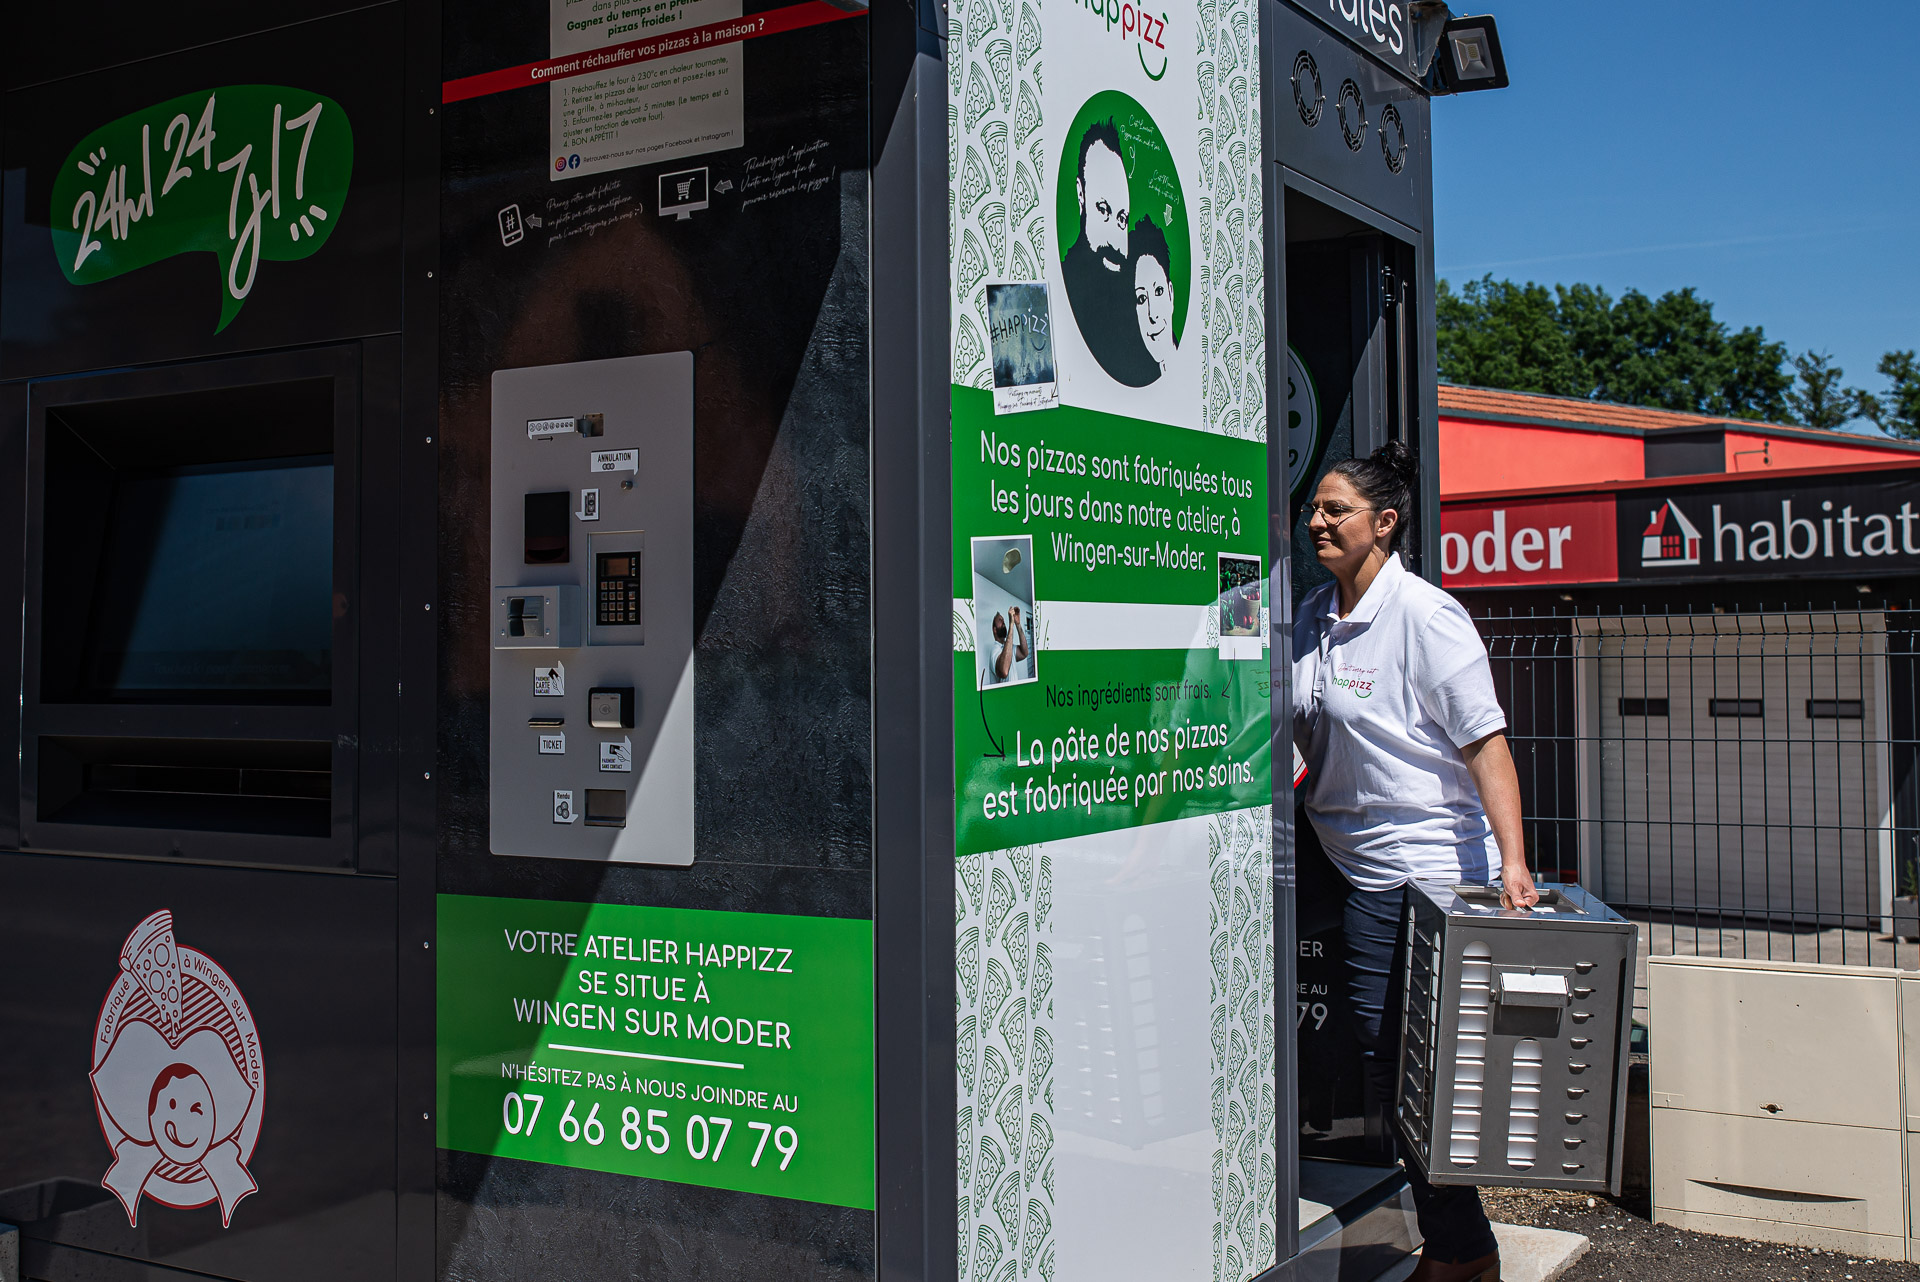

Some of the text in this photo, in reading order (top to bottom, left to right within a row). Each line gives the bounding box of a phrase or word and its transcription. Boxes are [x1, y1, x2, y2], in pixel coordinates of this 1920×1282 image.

[566, 1, 667, 31] Gagnez du temps en
[592, 2, 612, 12] dans
[608, 12, 676, 38] pizzas froides
[531, 18, 765, 79] Comment réchauffer vos pizzas à la maison ?
[594, 92, 603, 100] les
[604, 88, 625, 100] pizzas
[627, 85, 636, 93] de
[637, 82, 649, 91] leur
[651, 79, 671, 89] carton
[718, 67, 729, 75] sur
[616, 76, 629, 85] four
[670, 63, 693, 75] chaleur
[643, 103, 649, 111] 5
[651, 99, 675, 110] minutes
[690, 92, 709, 103] temps
[712, 90, 722, 98] est
[563, 127, 583, 139] ajuster
[584, 126, 592, 134] en
[594, 121, 619, 133] fonction
[620, 118, 629, 127] de
[631, 116, 647, 125] votre
[571, 136, 588, 147] BON
[647, 144, 664, 153] pages
[665, 137, 692, 149] Facebook
[598, 452, 632, 463] ANNULATION
[980, 430, 1253, 499] Nos pizzas sont fabriquées tous
[991, 479, 1241, 540] les jours dans notre atelier, à
[1713, 499, 1920, 562] habitat
[1051, 532, 1207, 572] Wingen-sur-Moder.
[536, 681, 550, 689] CARTE
[1046, 679, 1212, 712] Nos ingrédients sont frais.
[543, 740, 563, 750] TICKET
[1016, 718, 1228, 773] La pâte de nos pizzas
[557, 792, 570, 800] Rendu
[983, 755, 1254, 821] est fabriquée par nos soins.
[504, 928, 794, 974] VOTRE ATELIER HAPPIZZ
[578, 969, 711, 1005] SE SITUE À
[1311, 984, 1328, 995] AU
[100, 954, 261, 1089] Fabriqué à Wingen sur Moder
[513, 997, 792, 1050] WINGEN SUR MODER
[1297, 1002, 1328, 1031] 79
[501, 1060, 799, 1113] N'HÉSITEZ PAS À NOUS JOINDRE AU
[503, 1091, 800, 1172] 07 66 85 07 79
